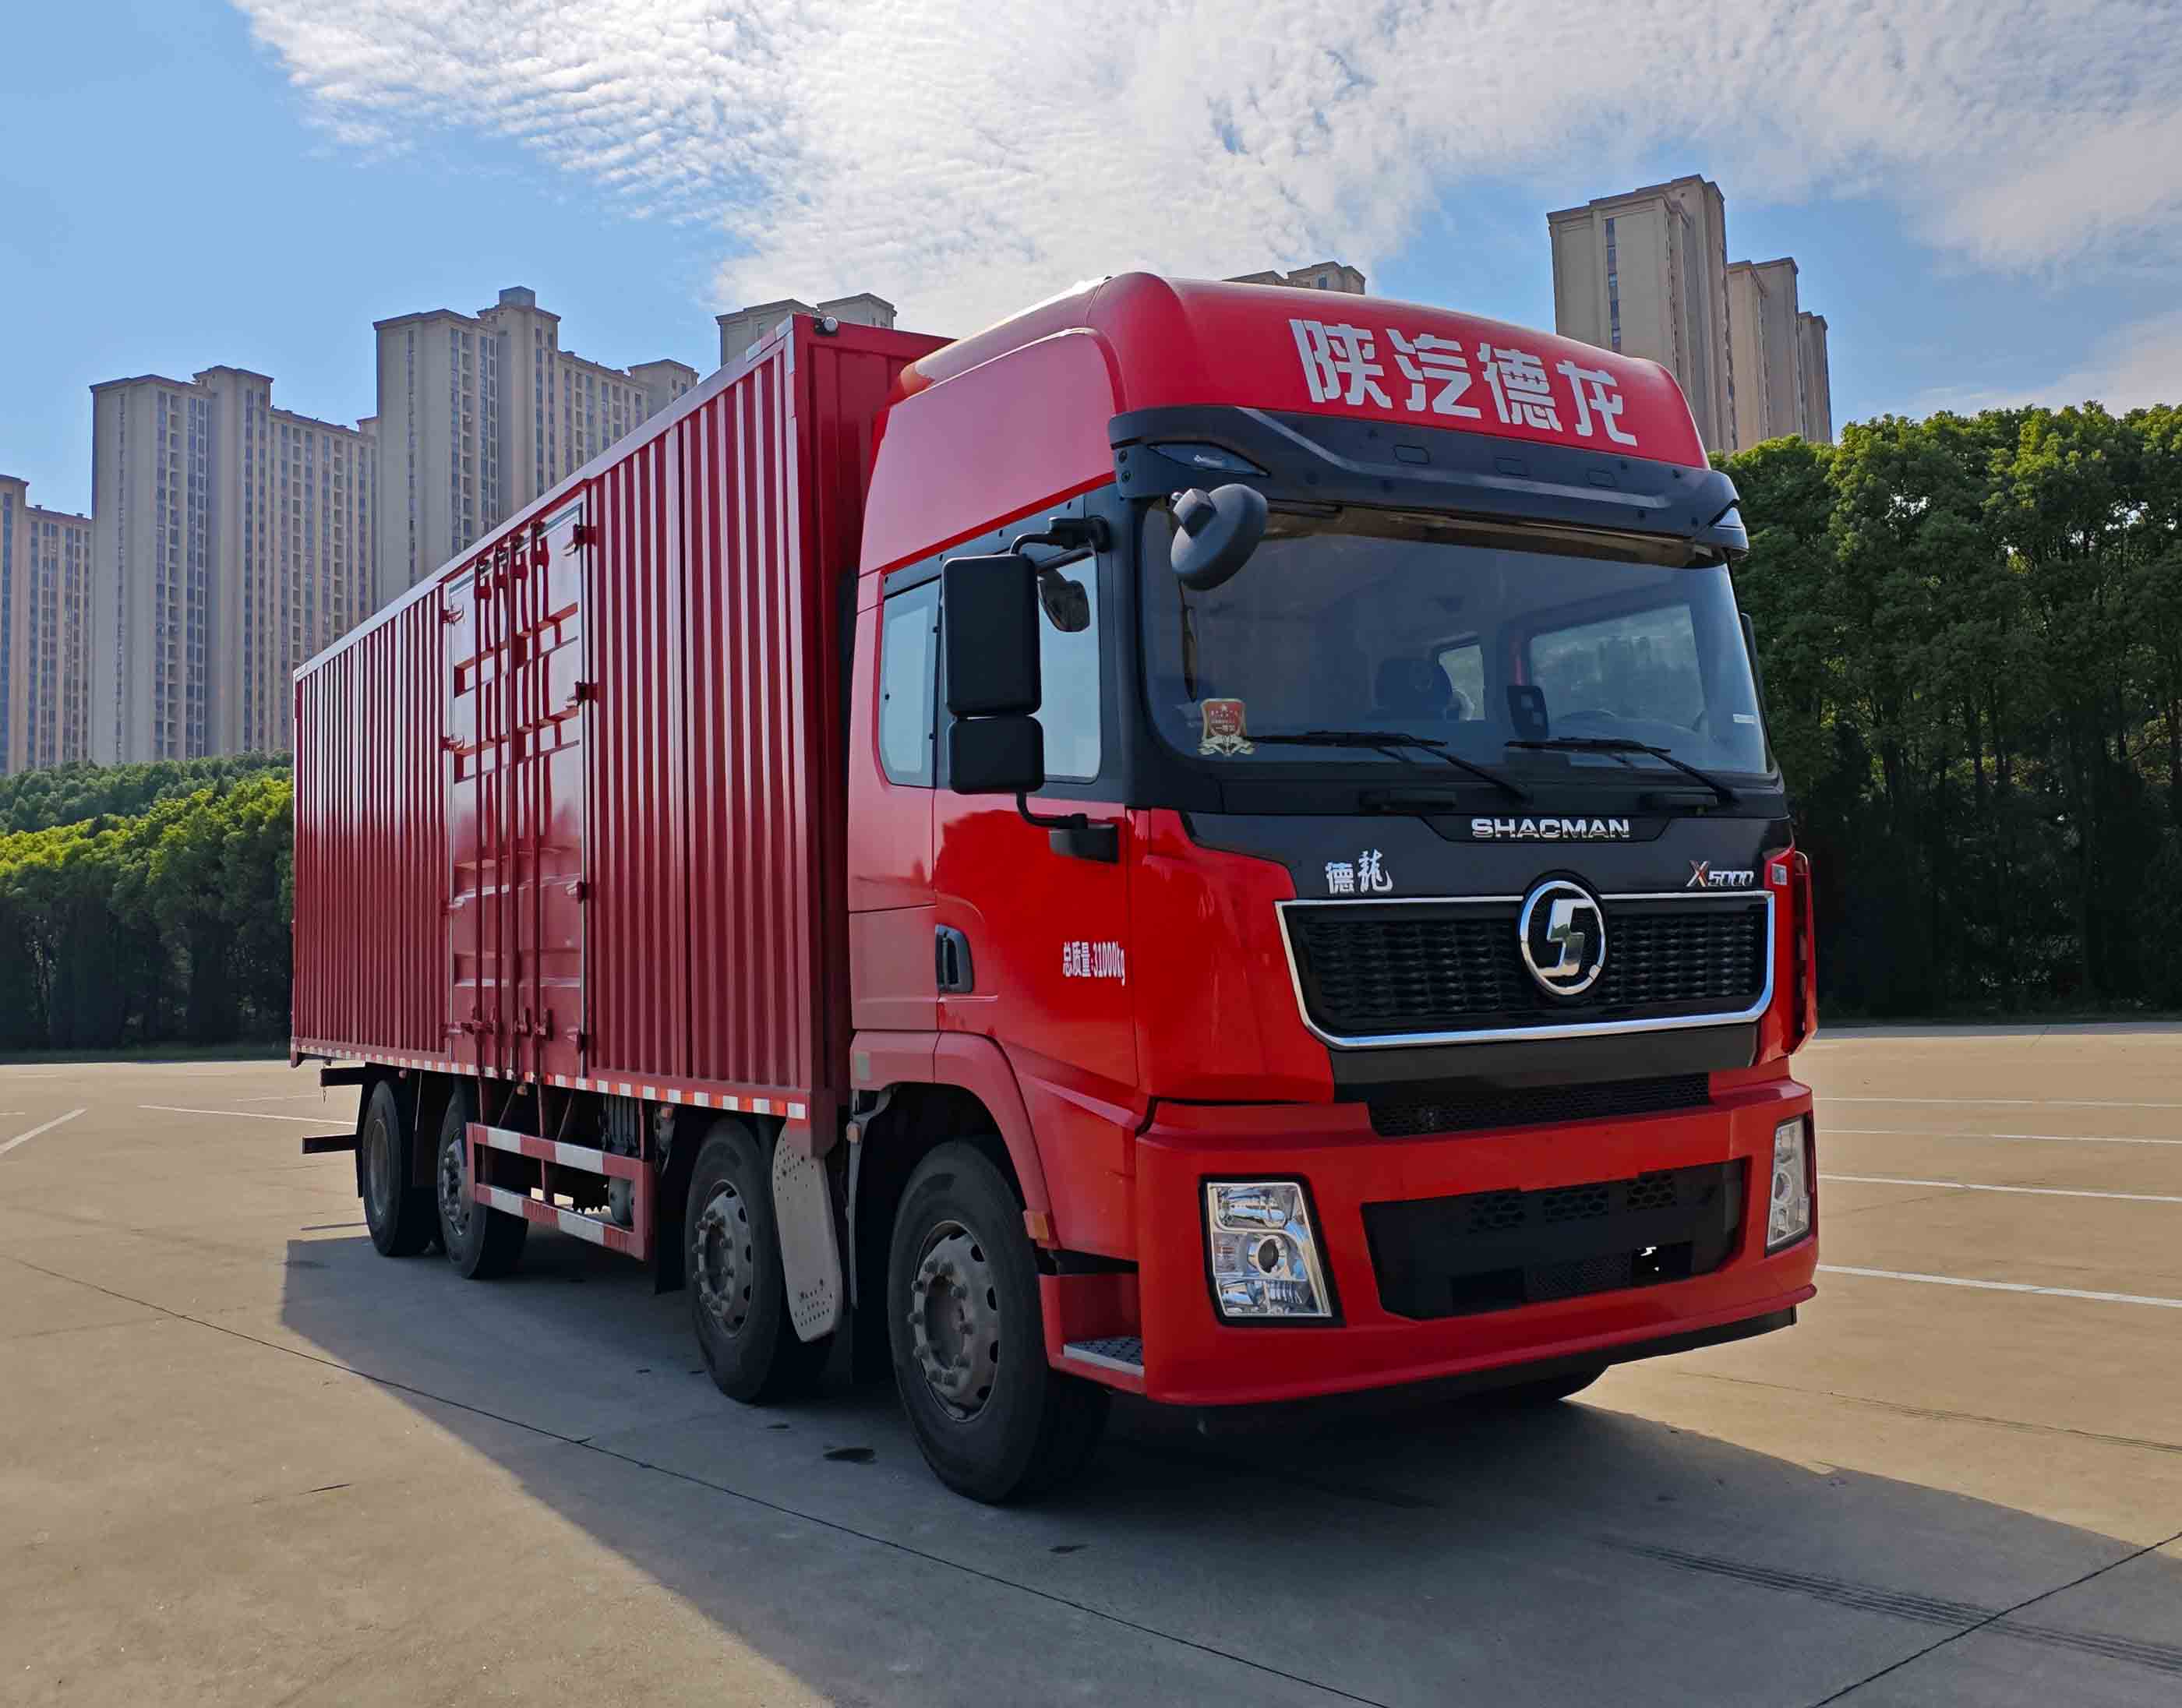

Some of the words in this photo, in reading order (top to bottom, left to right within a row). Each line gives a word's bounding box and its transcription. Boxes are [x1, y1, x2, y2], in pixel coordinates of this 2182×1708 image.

[1288, 318, 1637, 446] 陕汽德龙
[1471, 818, 1630, 838] SHACMAN
[1686, 859, 1754, 887] X5000
